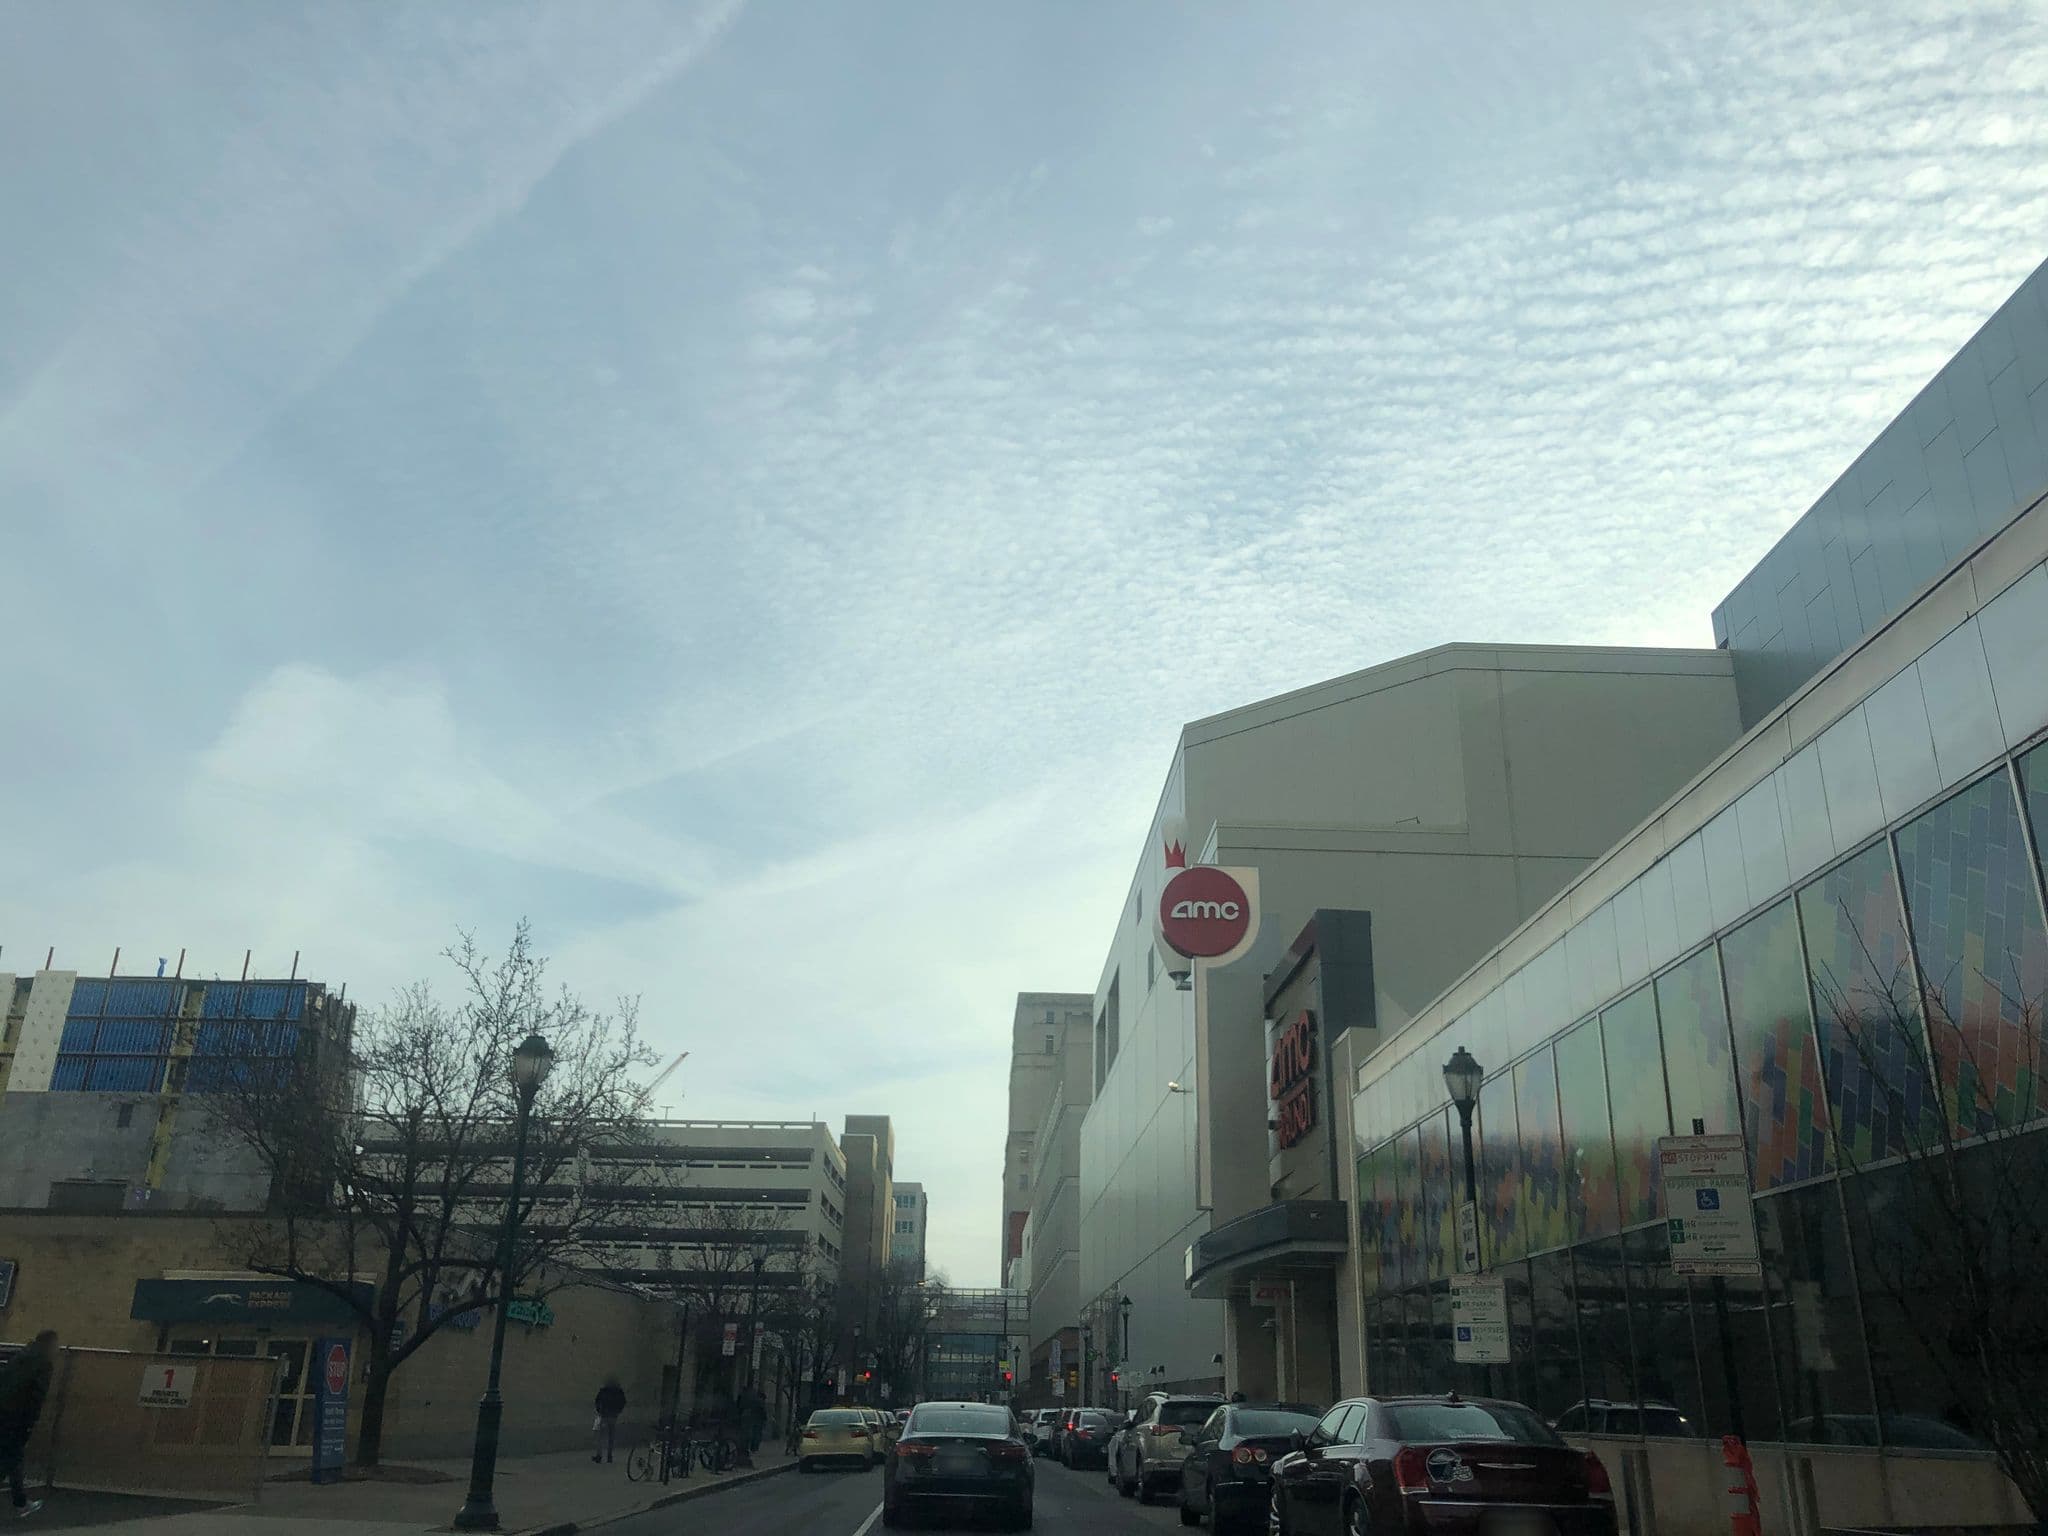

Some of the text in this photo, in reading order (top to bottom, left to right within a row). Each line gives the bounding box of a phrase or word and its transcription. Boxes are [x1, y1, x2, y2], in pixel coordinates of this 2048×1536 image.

[1678, 1151, 1728, 1162] STOPPING
[328, 1361, 346, 1377] STOP
[164, 1369, 175, 1388] 1
